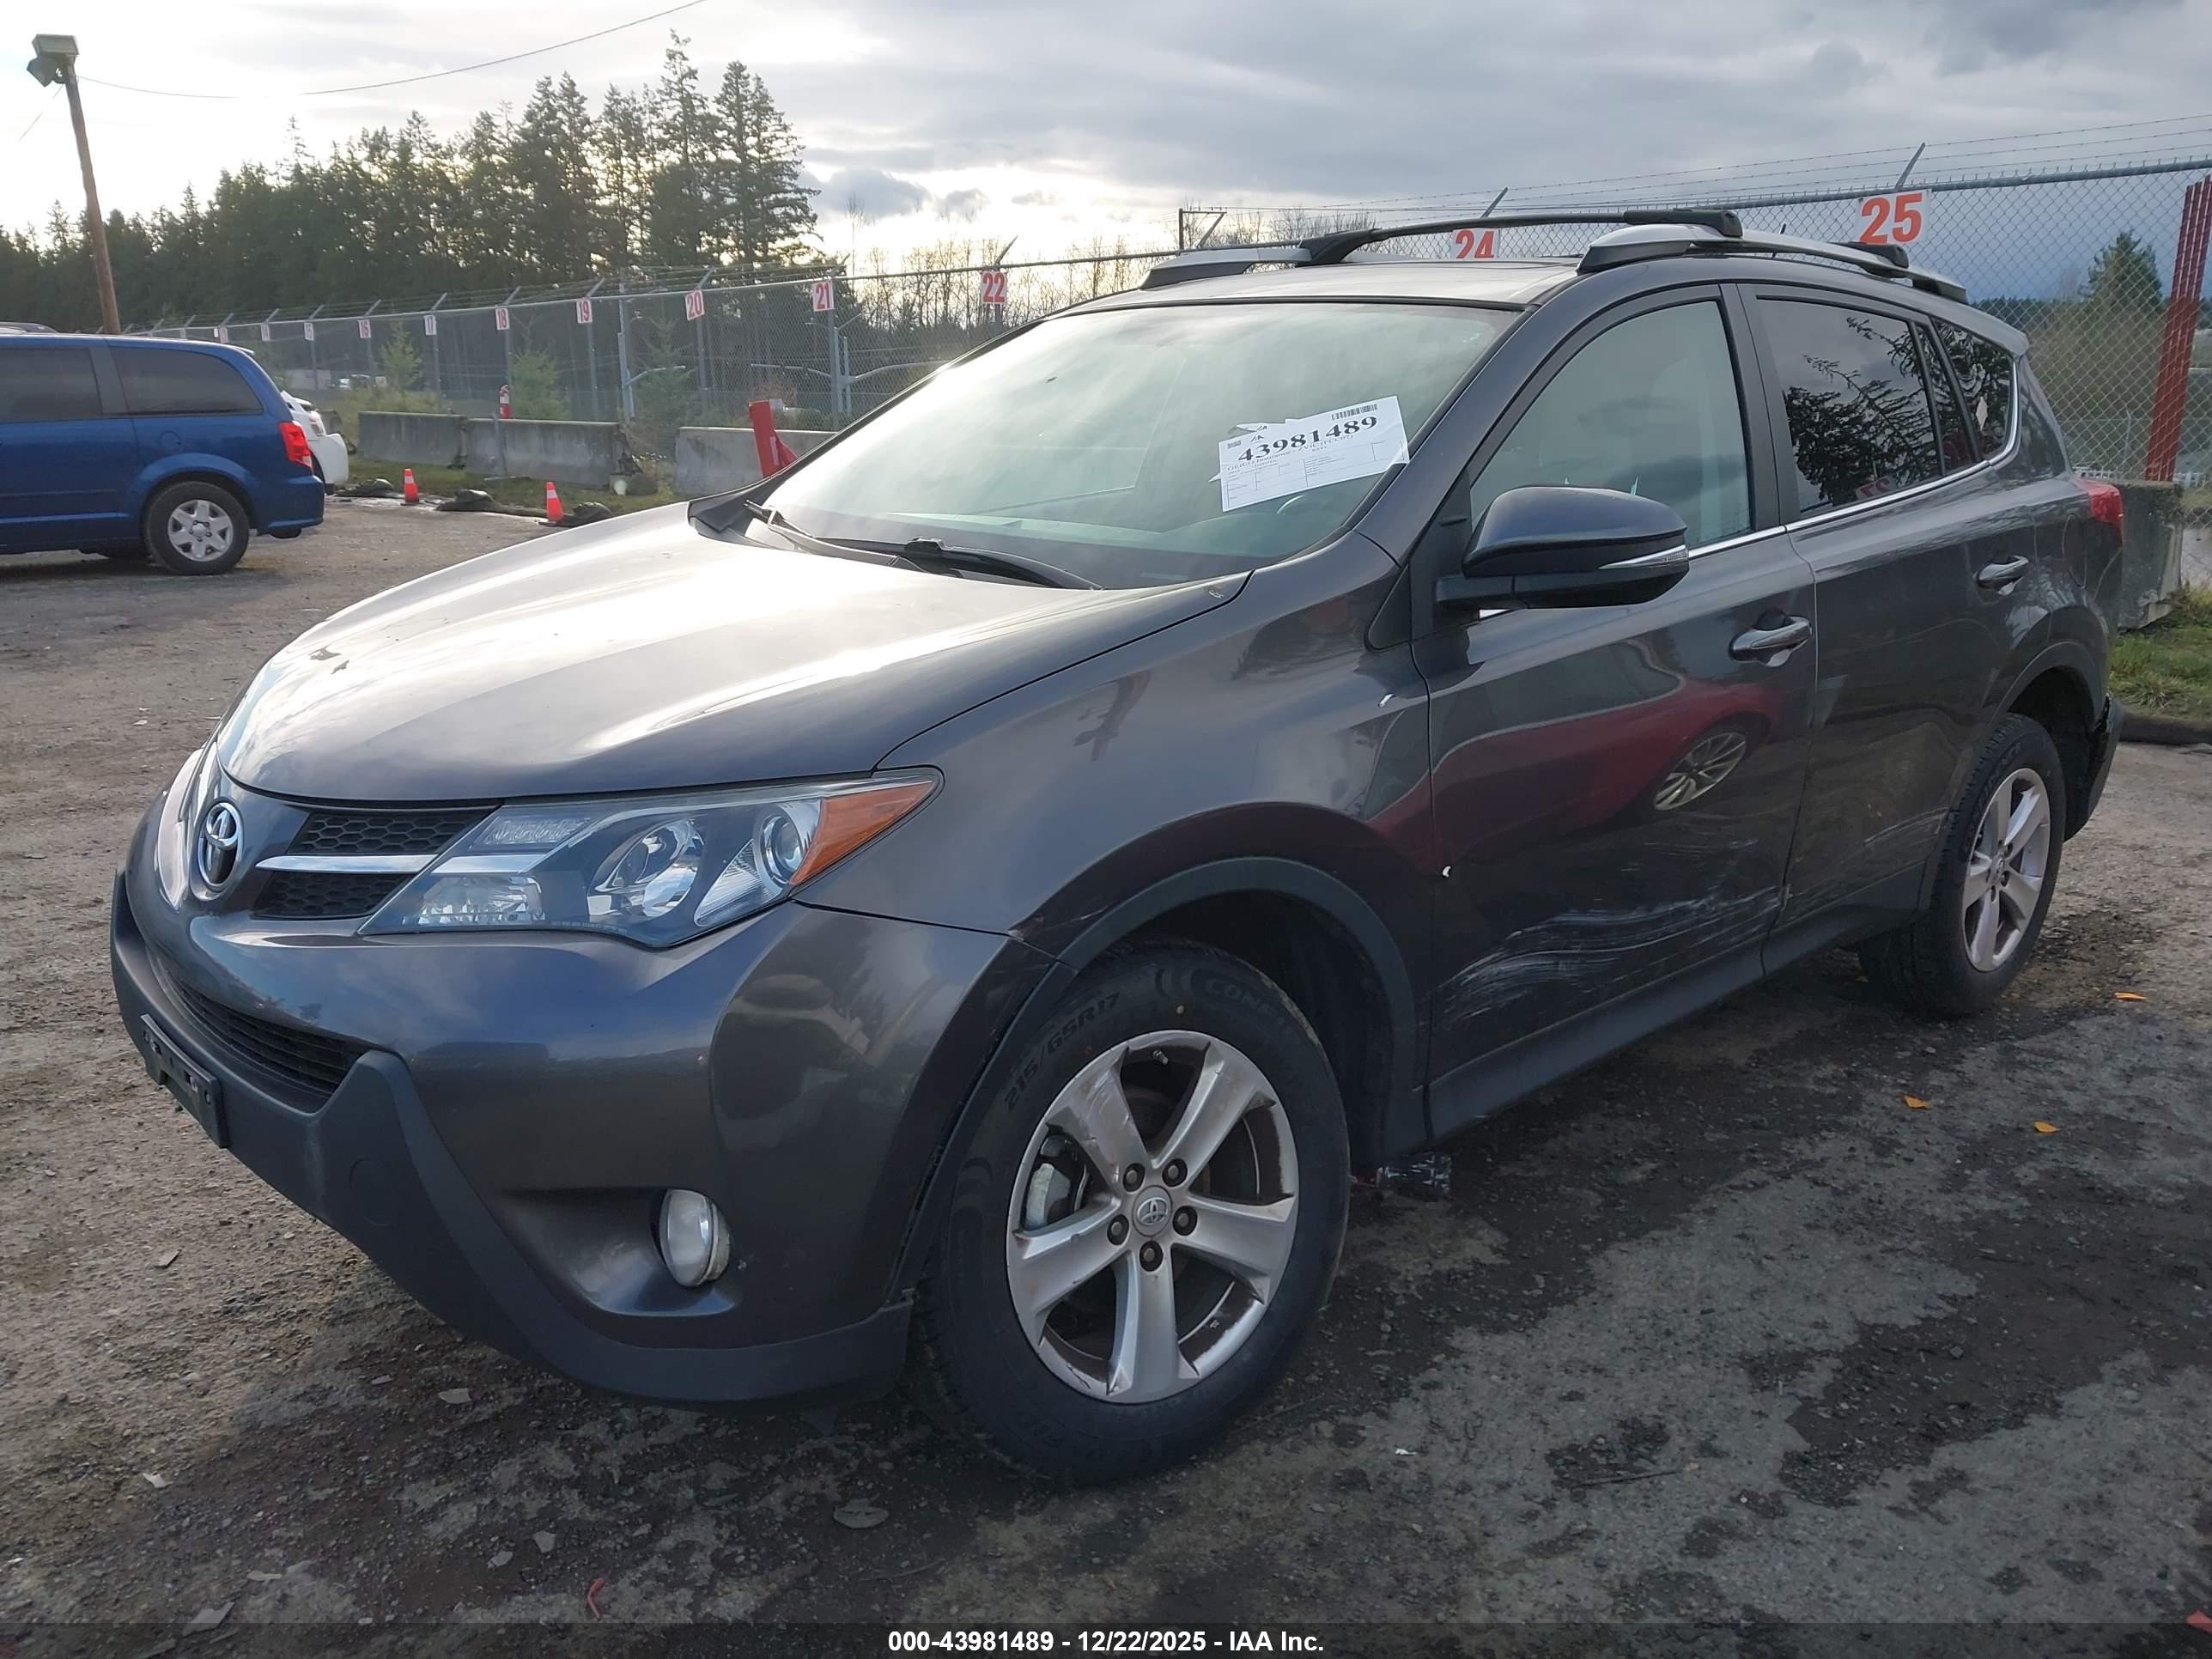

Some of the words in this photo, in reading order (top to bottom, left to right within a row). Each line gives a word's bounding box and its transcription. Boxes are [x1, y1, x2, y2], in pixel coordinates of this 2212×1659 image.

[1859, 191, 1923, 246] 25
[1455, 229, 1495, 259] 24
[816, 282, 830, 310] 21
[982, 273, 1005, 303] 22
[497, 308, 508, 329] 18
[579, 300, 591, 322] 19
[688, 290, 702, 319] 20
[1237, 416, 1377, 462] 43981489
